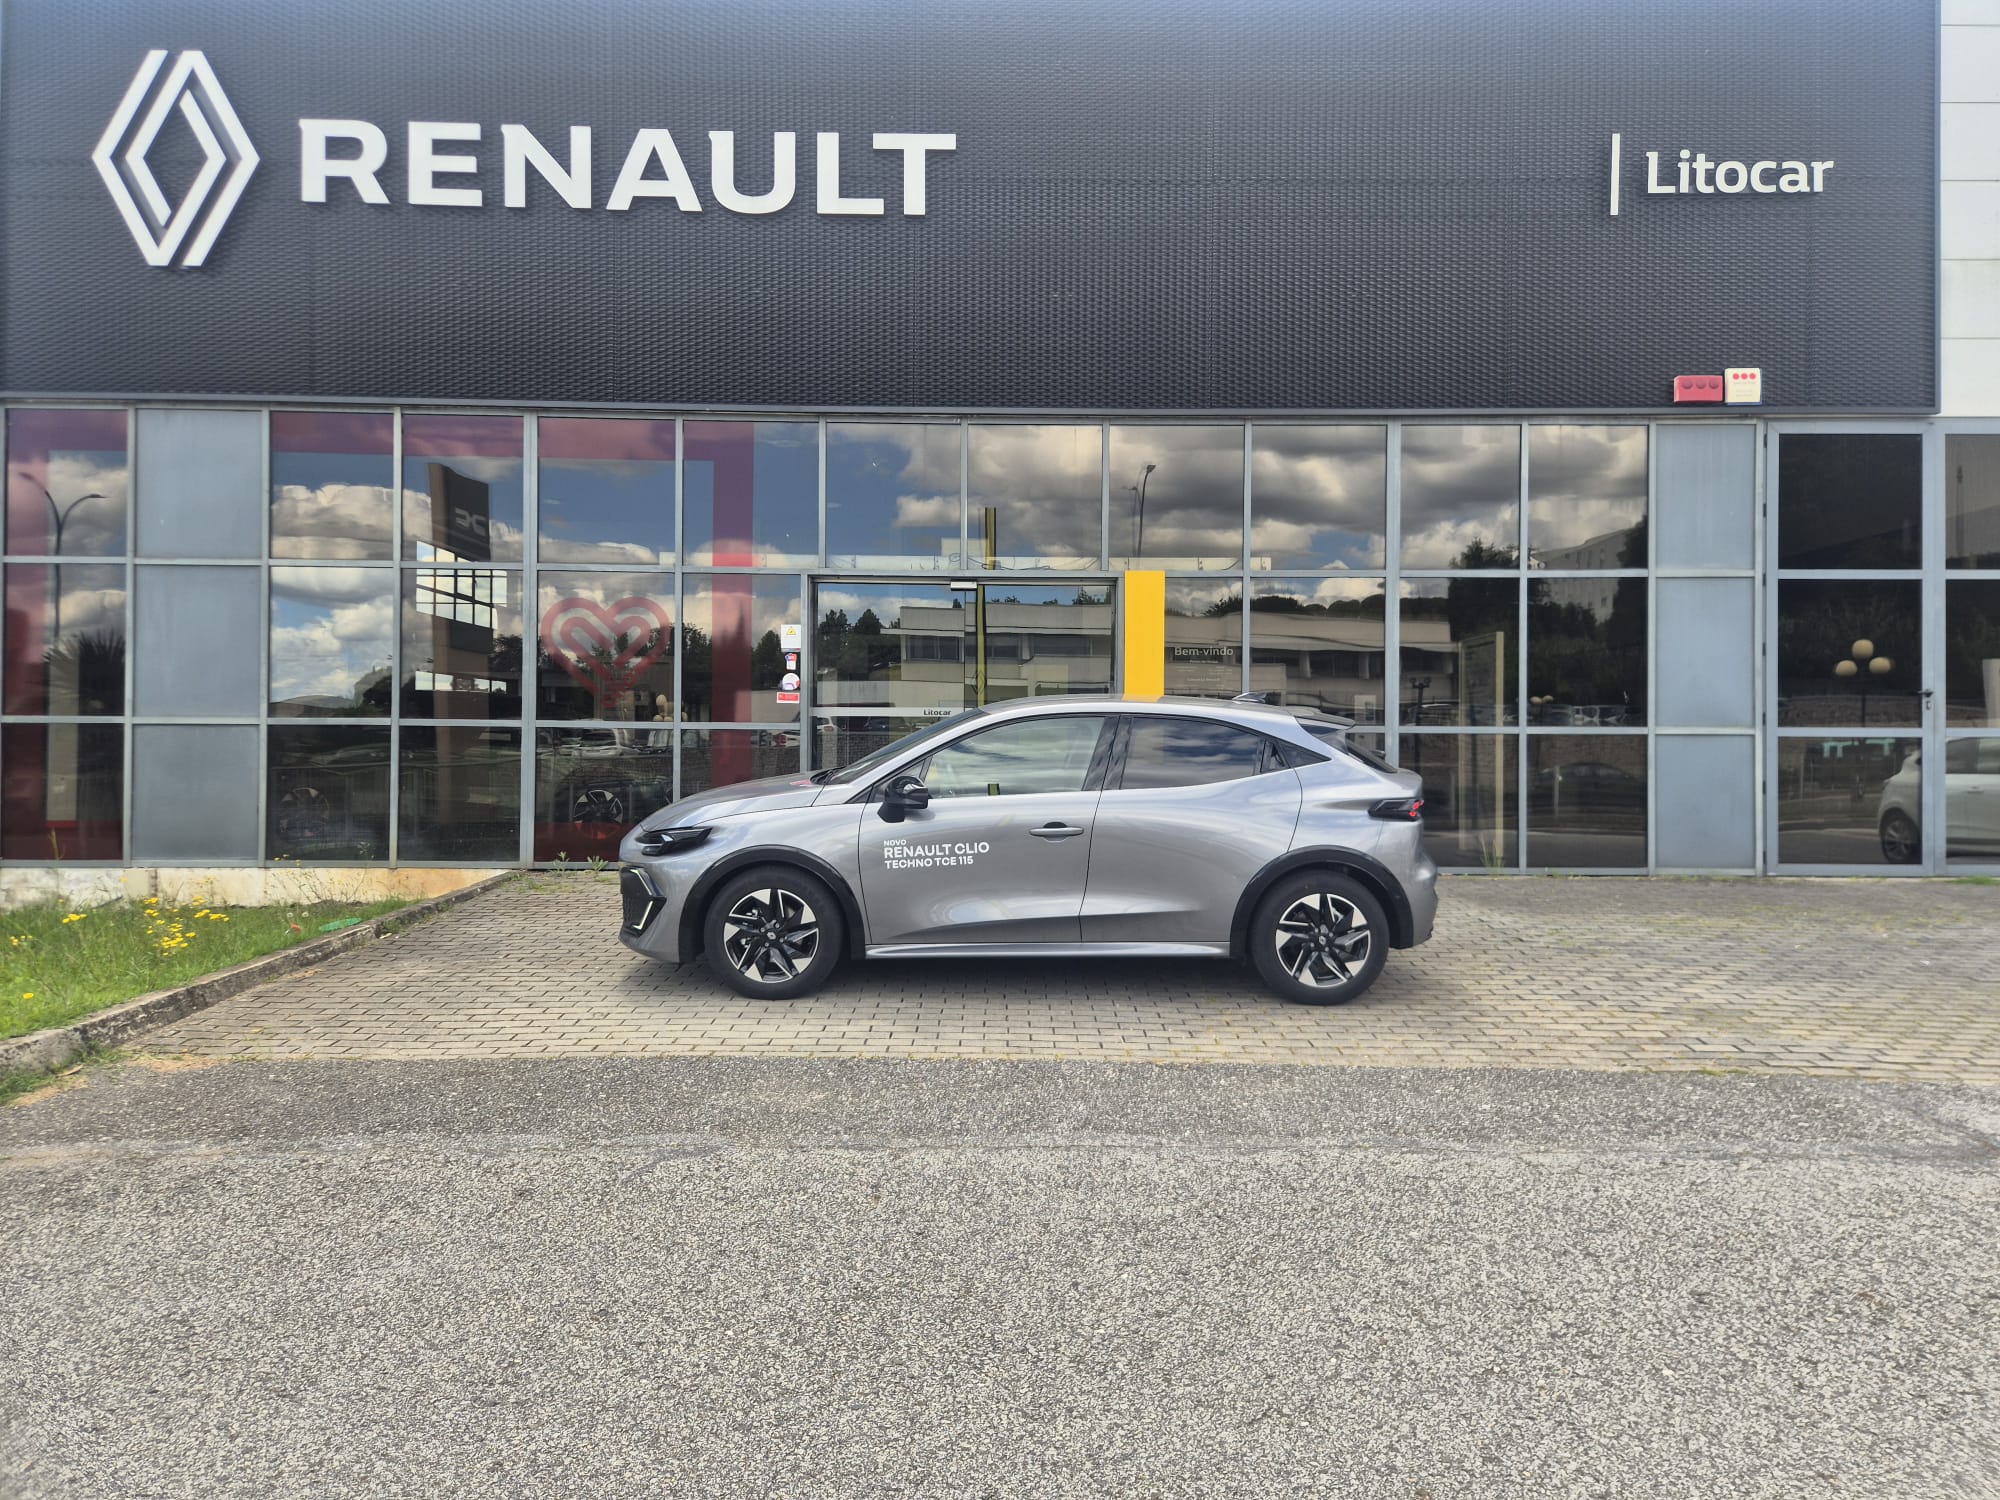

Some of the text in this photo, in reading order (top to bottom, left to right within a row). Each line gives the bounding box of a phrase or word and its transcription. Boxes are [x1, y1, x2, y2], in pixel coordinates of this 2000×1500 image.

[298, 118, 957, 216] RENAULT
[1645, 148, 1835, 194] Litocar
[1174, 646, 1234, 656] Bem-vindo
[923, 708, 952, 716] Litocar
[884, 841, 990, 858] RENAULT CLIO
[884, 855, 974, 870] TECHNO TCE 115
